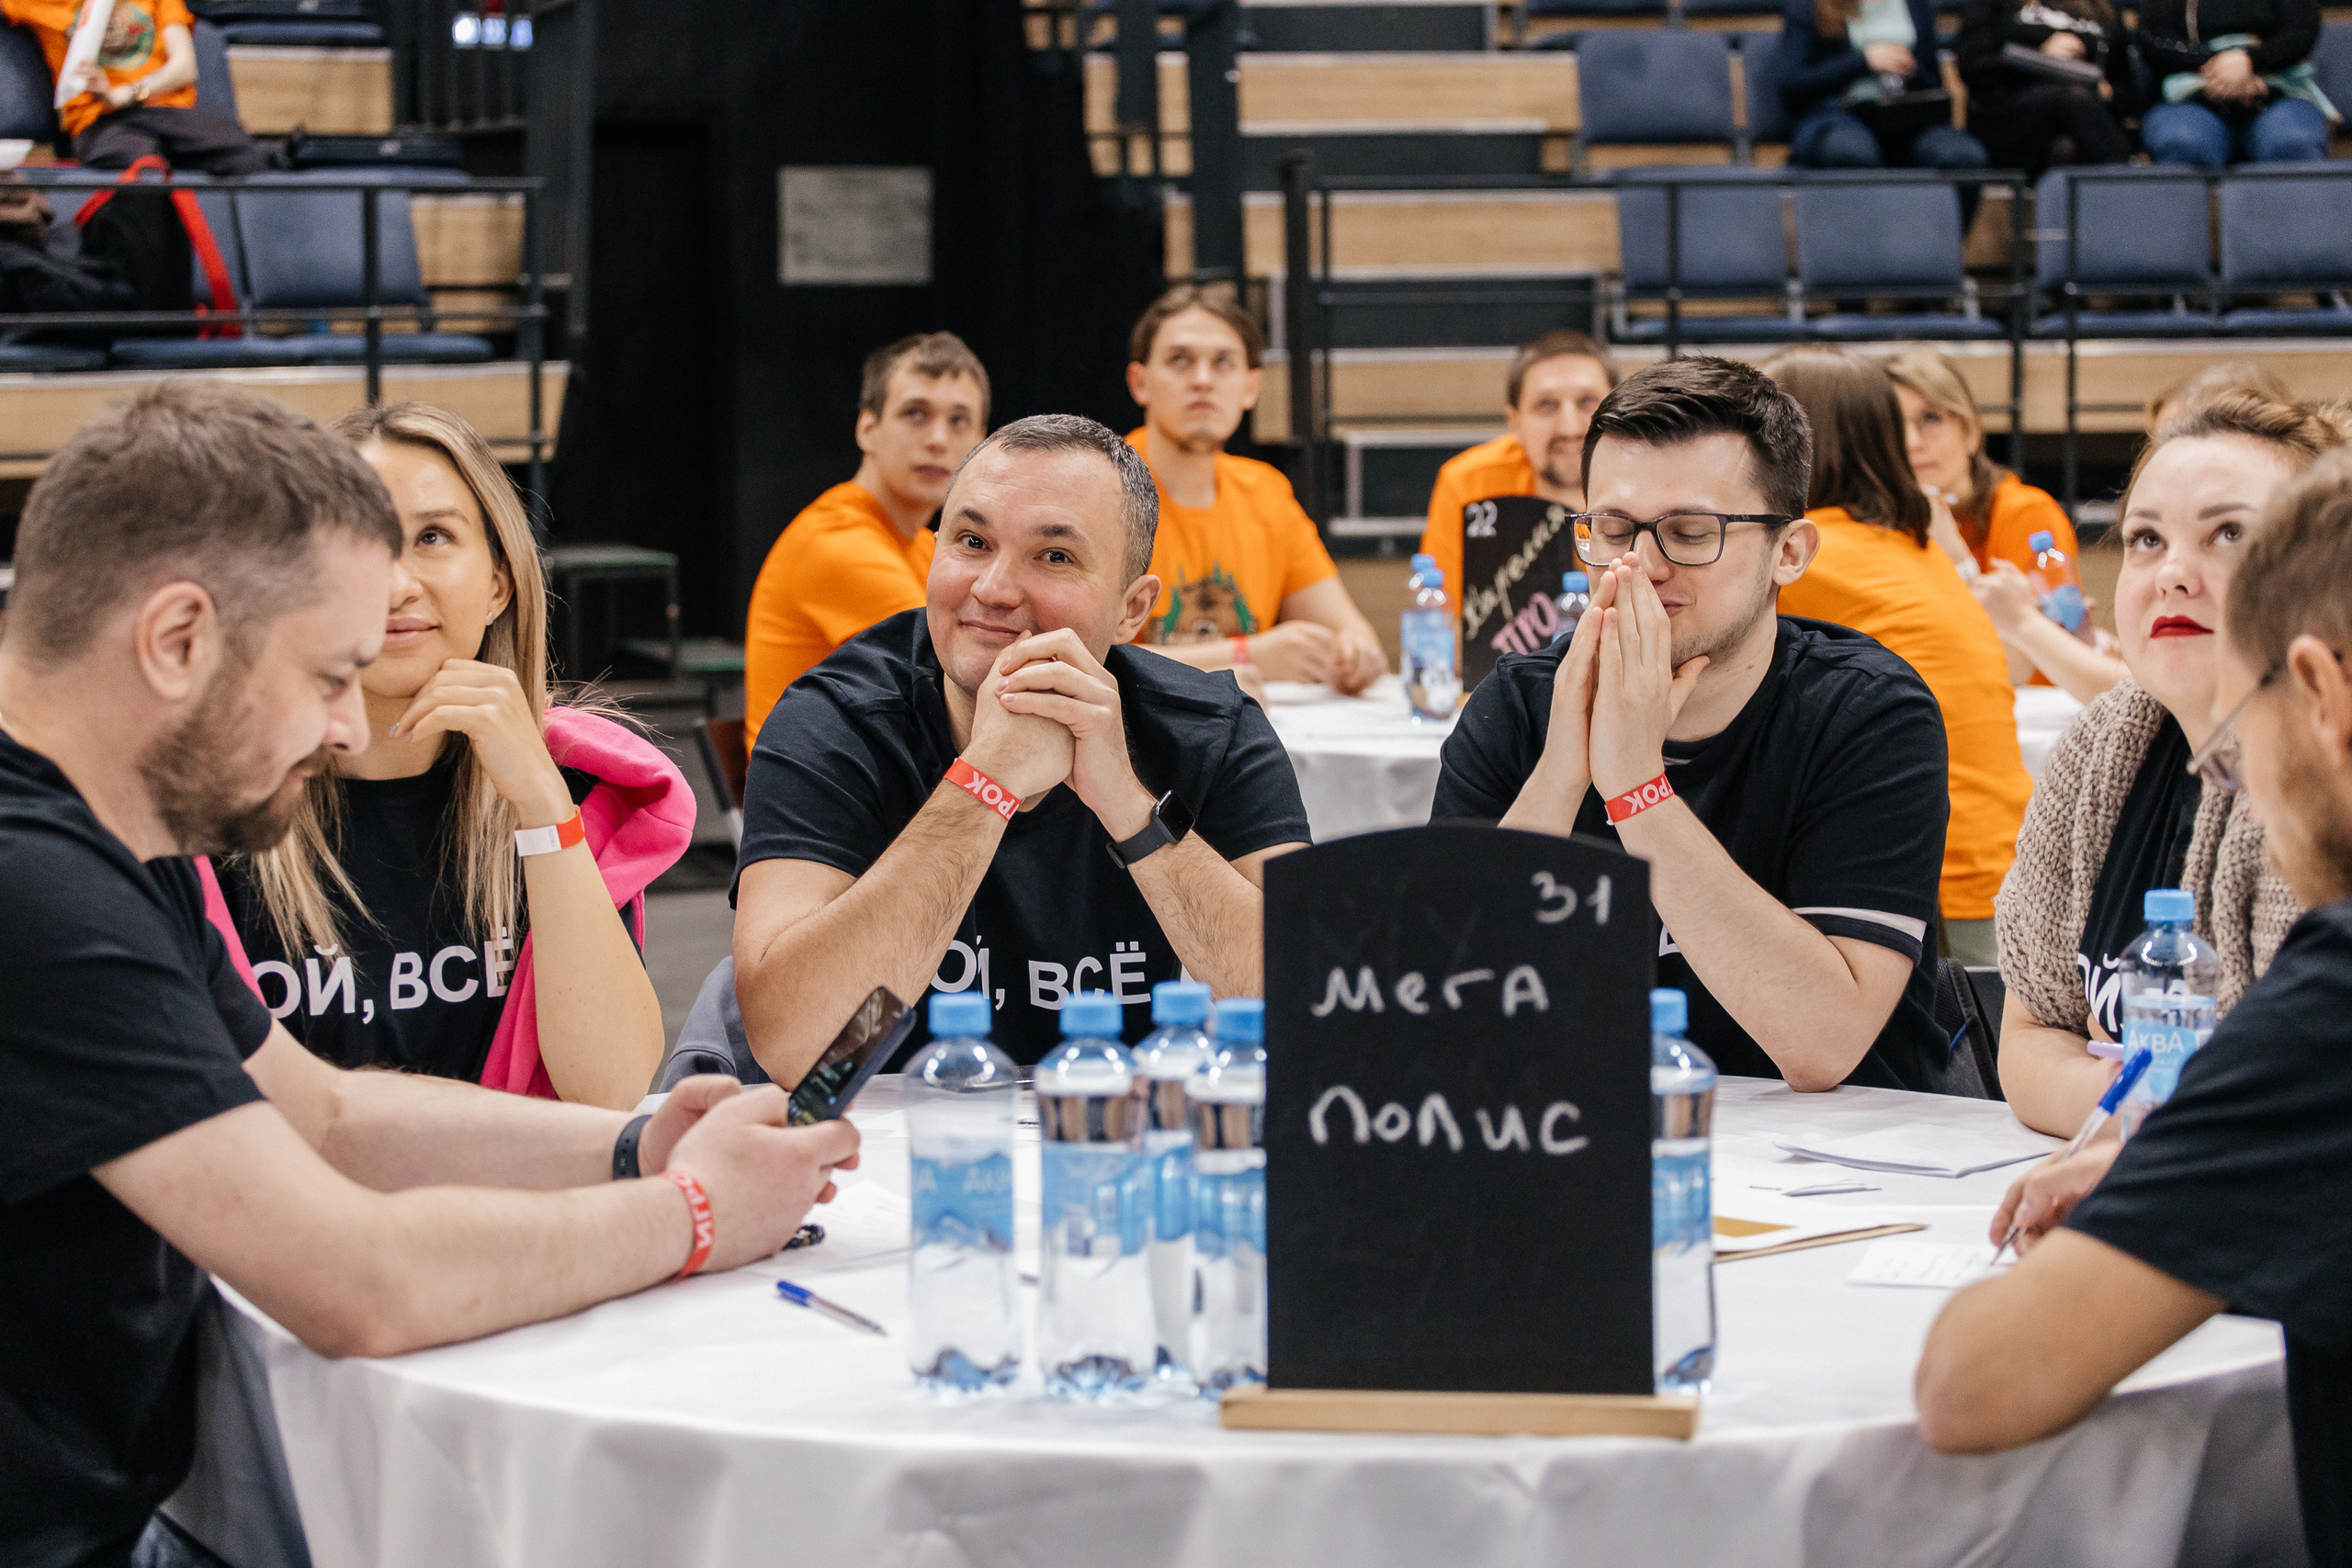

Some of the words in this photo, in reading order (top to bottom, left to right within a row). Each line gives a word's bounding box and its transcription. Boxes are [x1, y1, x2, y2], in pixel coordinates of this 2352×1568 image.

[1464, 500, 1498, 537] 22
[1531, 872, 1612, 925] 31
[390, 926, 514, 1010] ВСЁ
[1028, 941, 1152, 1010] ВСЁ
